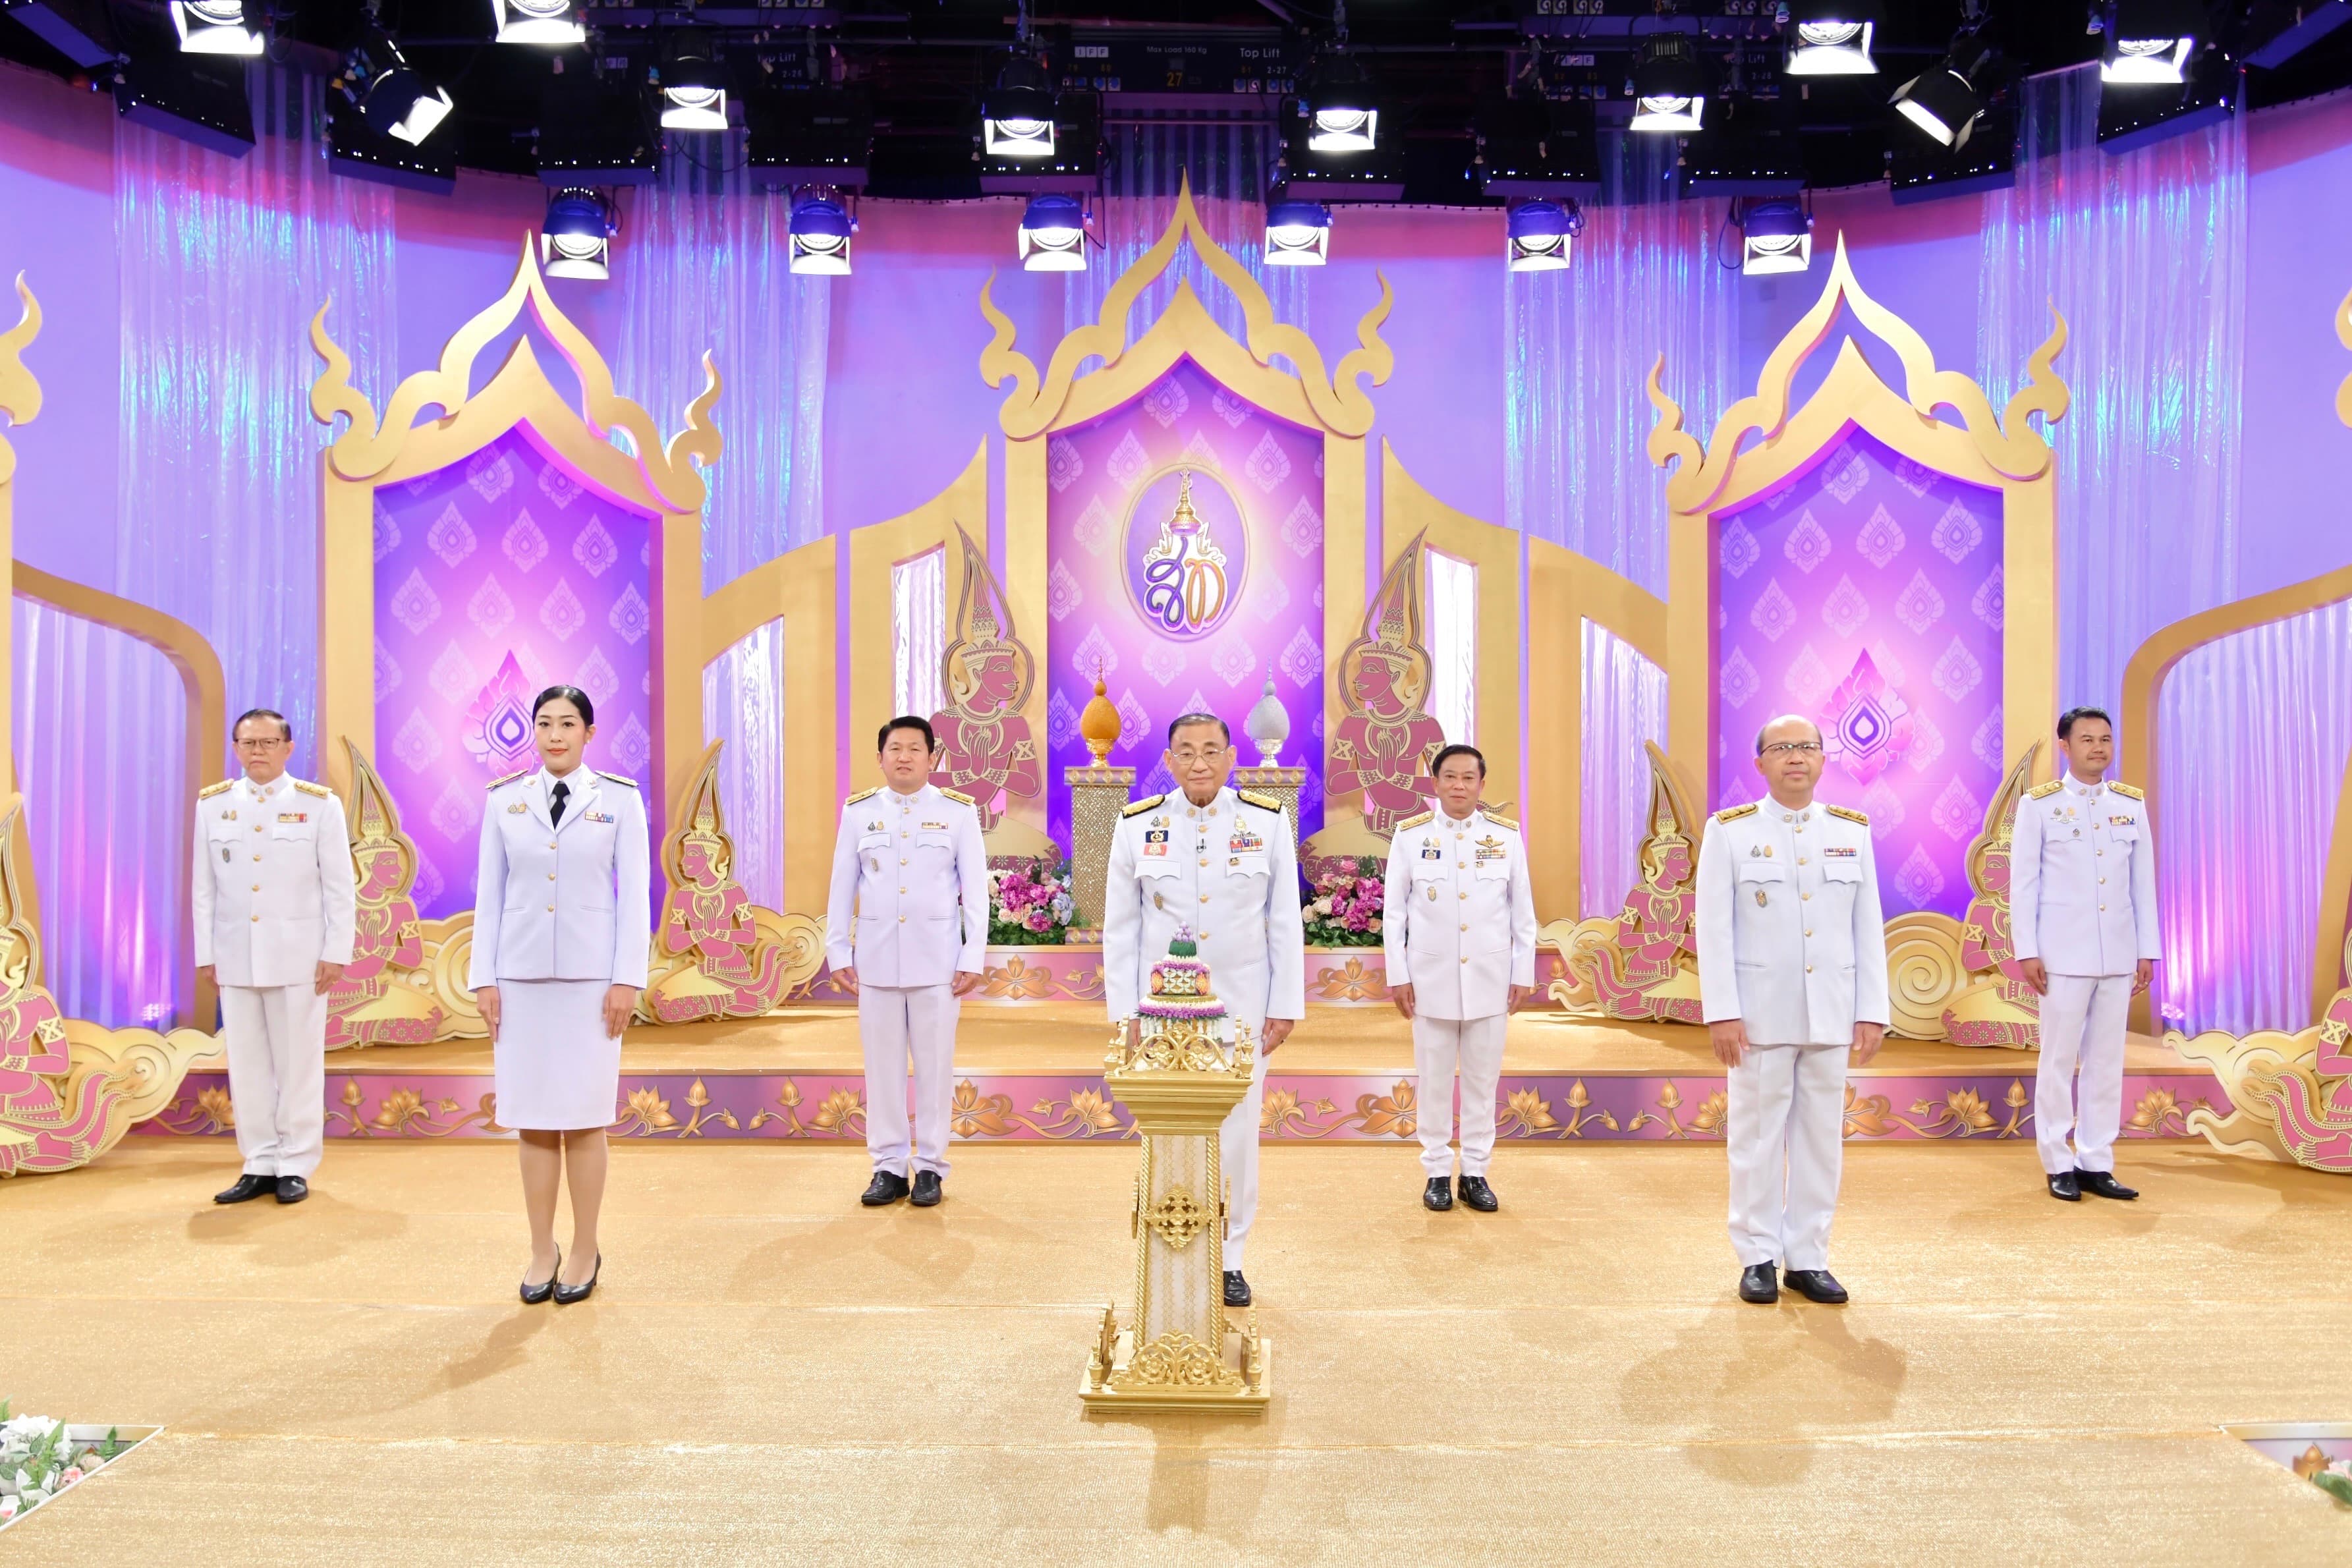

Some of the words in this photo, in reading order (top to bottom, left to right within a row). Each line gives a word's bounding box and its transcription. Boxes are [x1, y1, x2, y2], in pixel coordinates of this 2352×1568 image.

[1239, 47, 1259, 59] Top
[1262, 47, 1281, 58] Lift
[1166, 71, 1183, 88] 27
